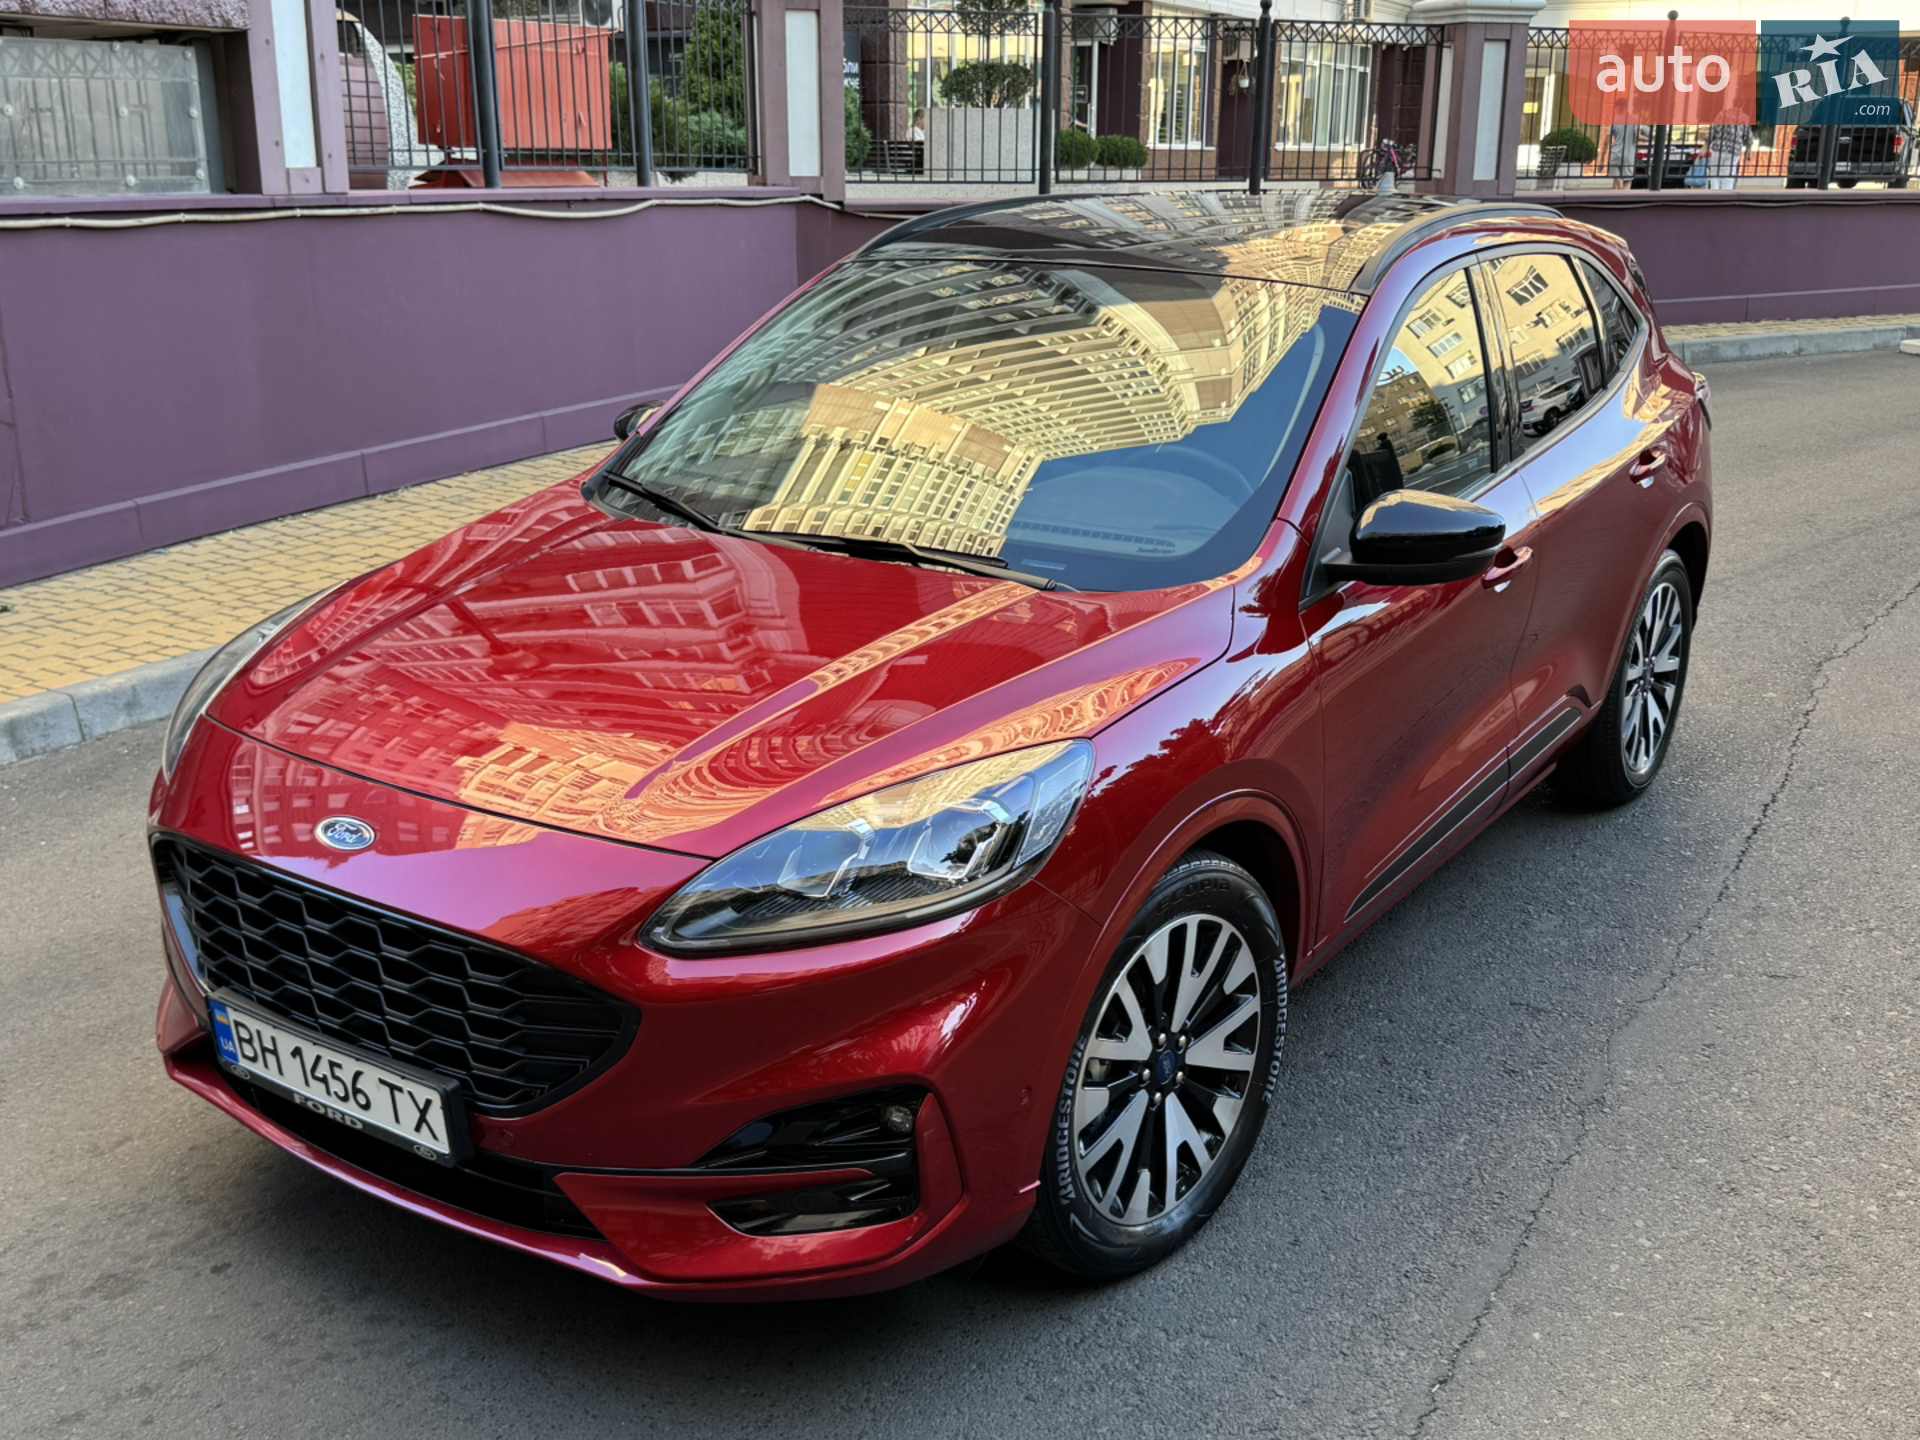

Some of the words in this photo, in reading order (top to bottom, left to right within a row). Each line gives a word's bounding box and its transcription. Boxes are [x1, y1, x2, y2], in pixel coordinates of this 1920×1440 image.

[219, 1036, 236, 1054] UA
[233, 1018, 284, 1078] BH
[290, 1045, 372, 1112] 1456
[377, 1076, 440, 1142] TX
[1261, 953, 1288, 1104] BRIDGESTONE
[293, 1092, 364, 1131] FORD
[1056, 1034, 1087, 1205] BRIDGESTONE
